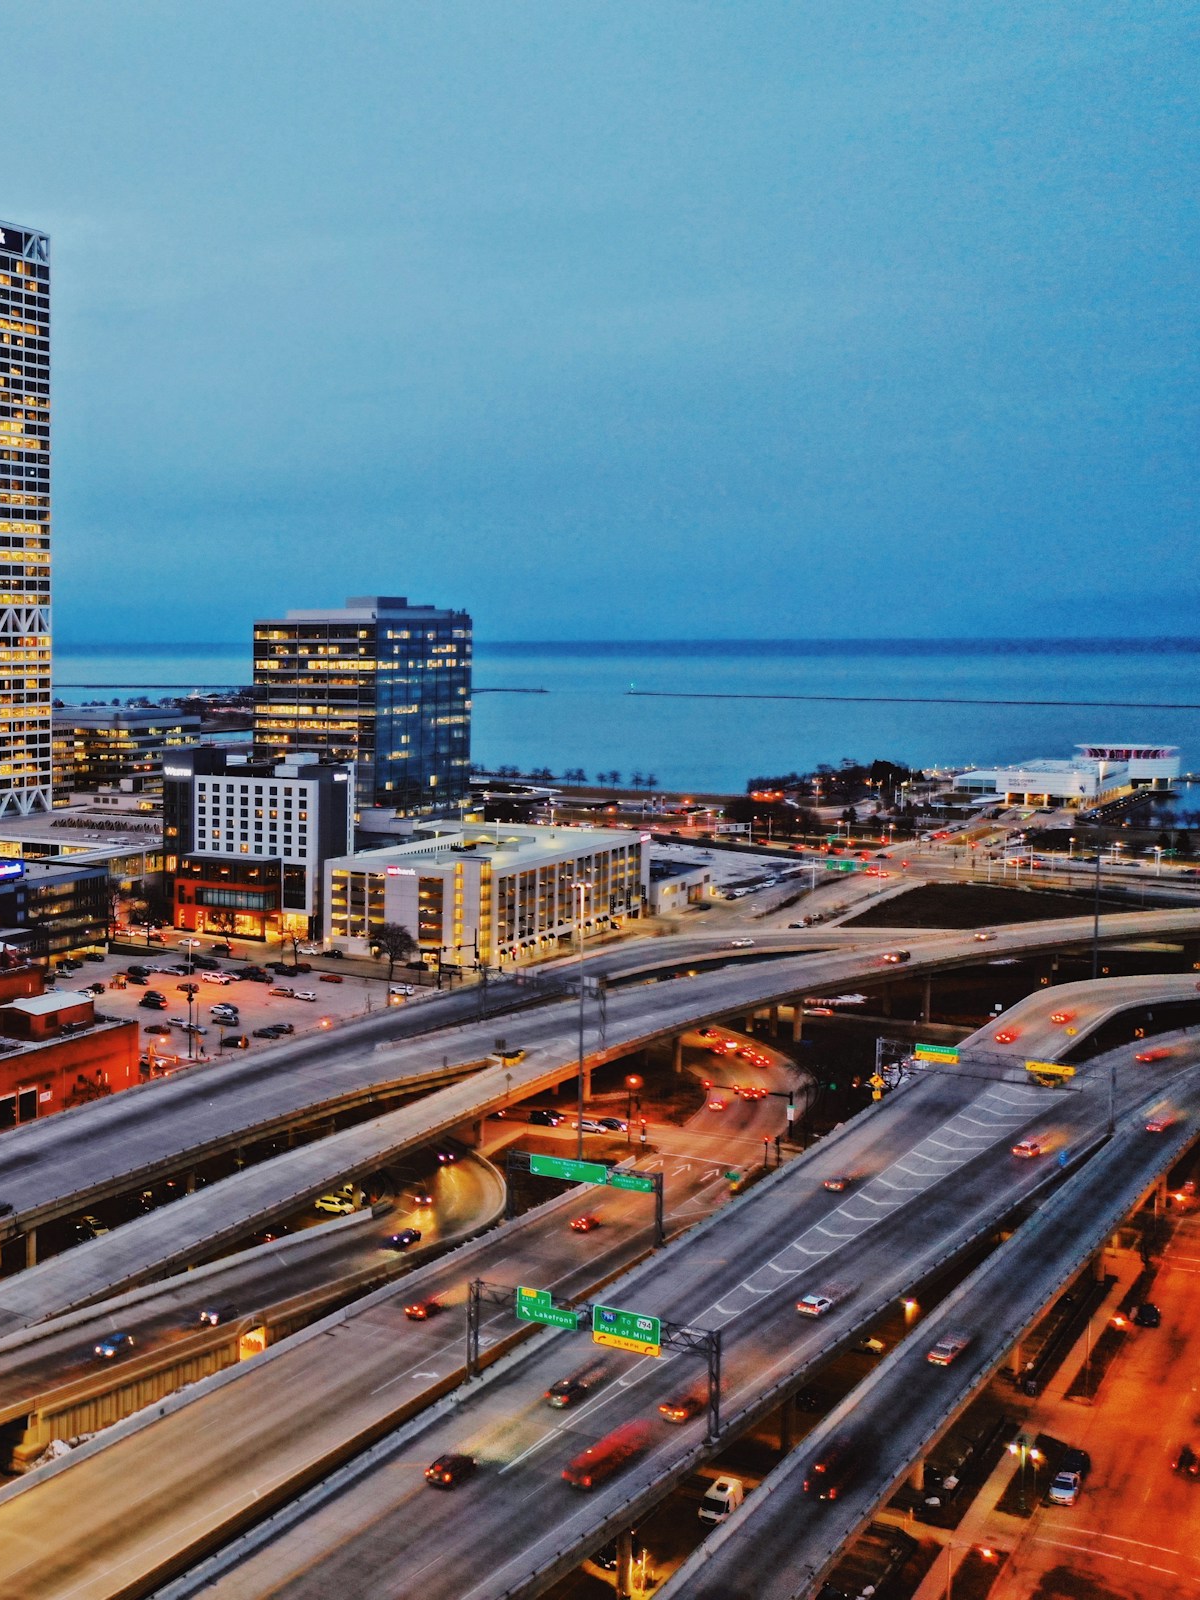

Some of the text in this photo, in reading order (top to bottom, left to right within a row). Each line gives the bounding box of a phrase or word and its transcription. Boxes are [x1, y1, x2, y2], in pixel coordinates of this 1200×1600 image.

[534, 1310, 572, 1324] Lakefront
[621, 1317, 631, 1325] To
[638, 1320, 652, 1330] 794
[599, 1324, 617, 1333] Port
[633, 1331, 652, 1341] Milw
